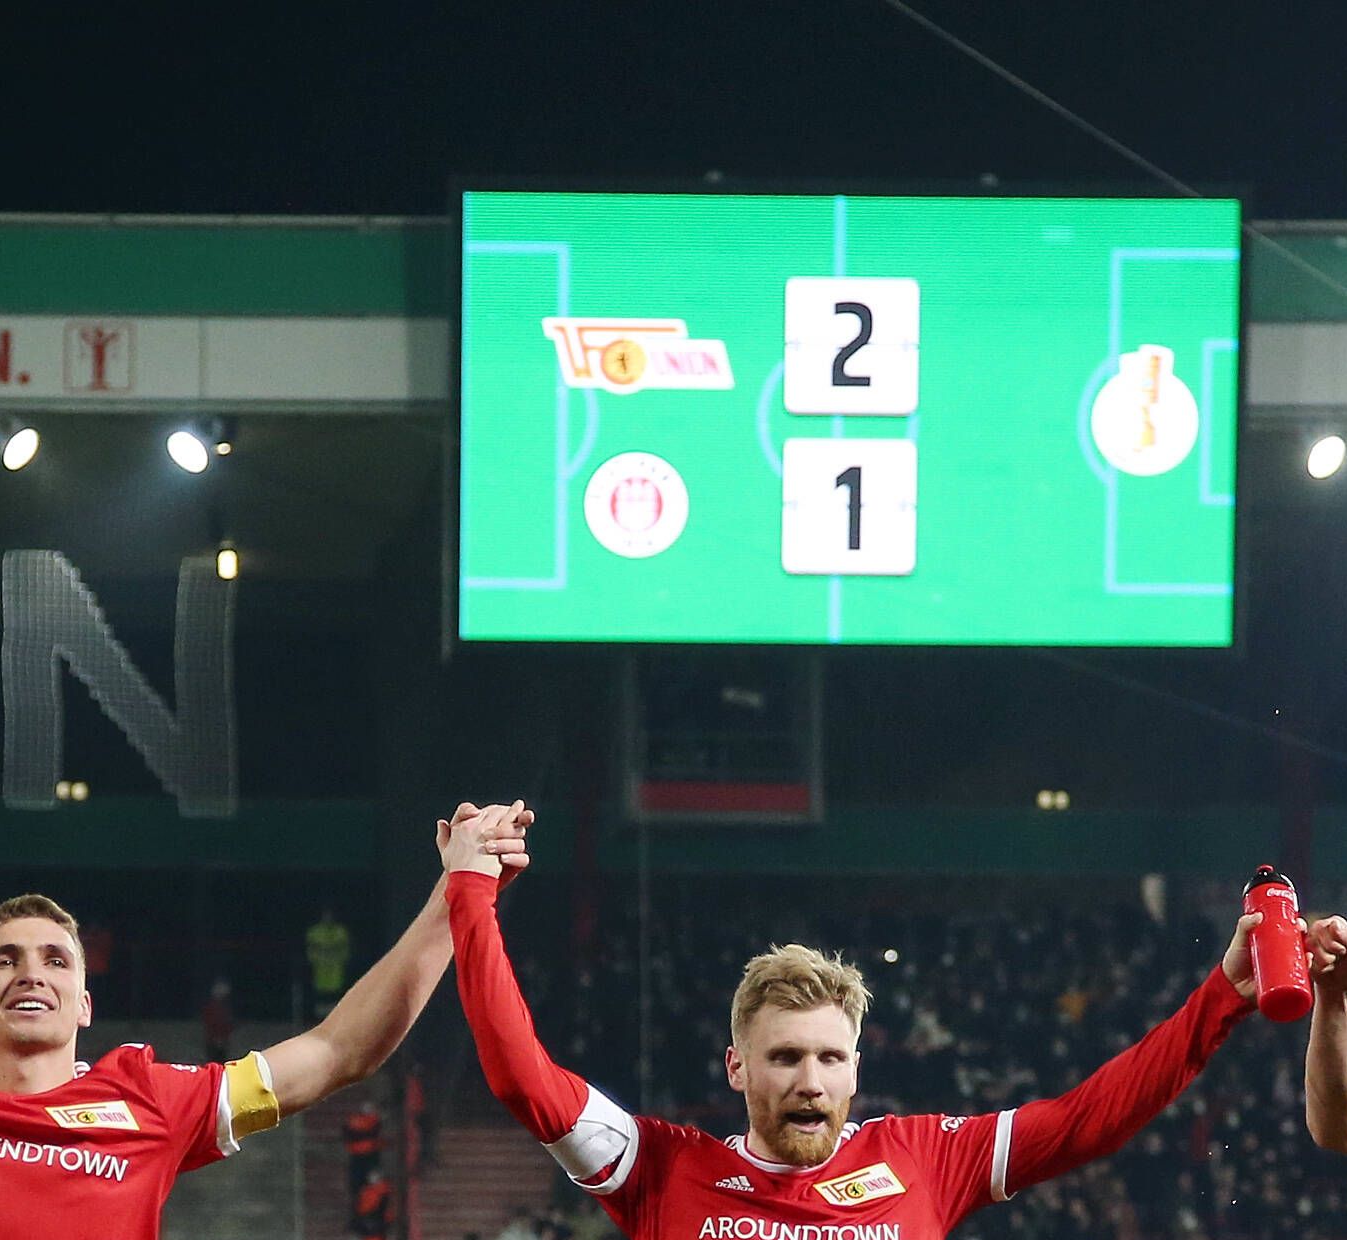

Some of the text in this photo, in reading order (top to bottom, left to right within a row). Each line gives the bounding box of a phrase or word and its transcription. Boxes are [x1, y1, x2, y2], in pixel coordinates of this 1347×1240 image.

[831, 301, 874, 388] 2
[833, 465, 865, 552] 1
[715, 1180, 754, 1193] adidas
